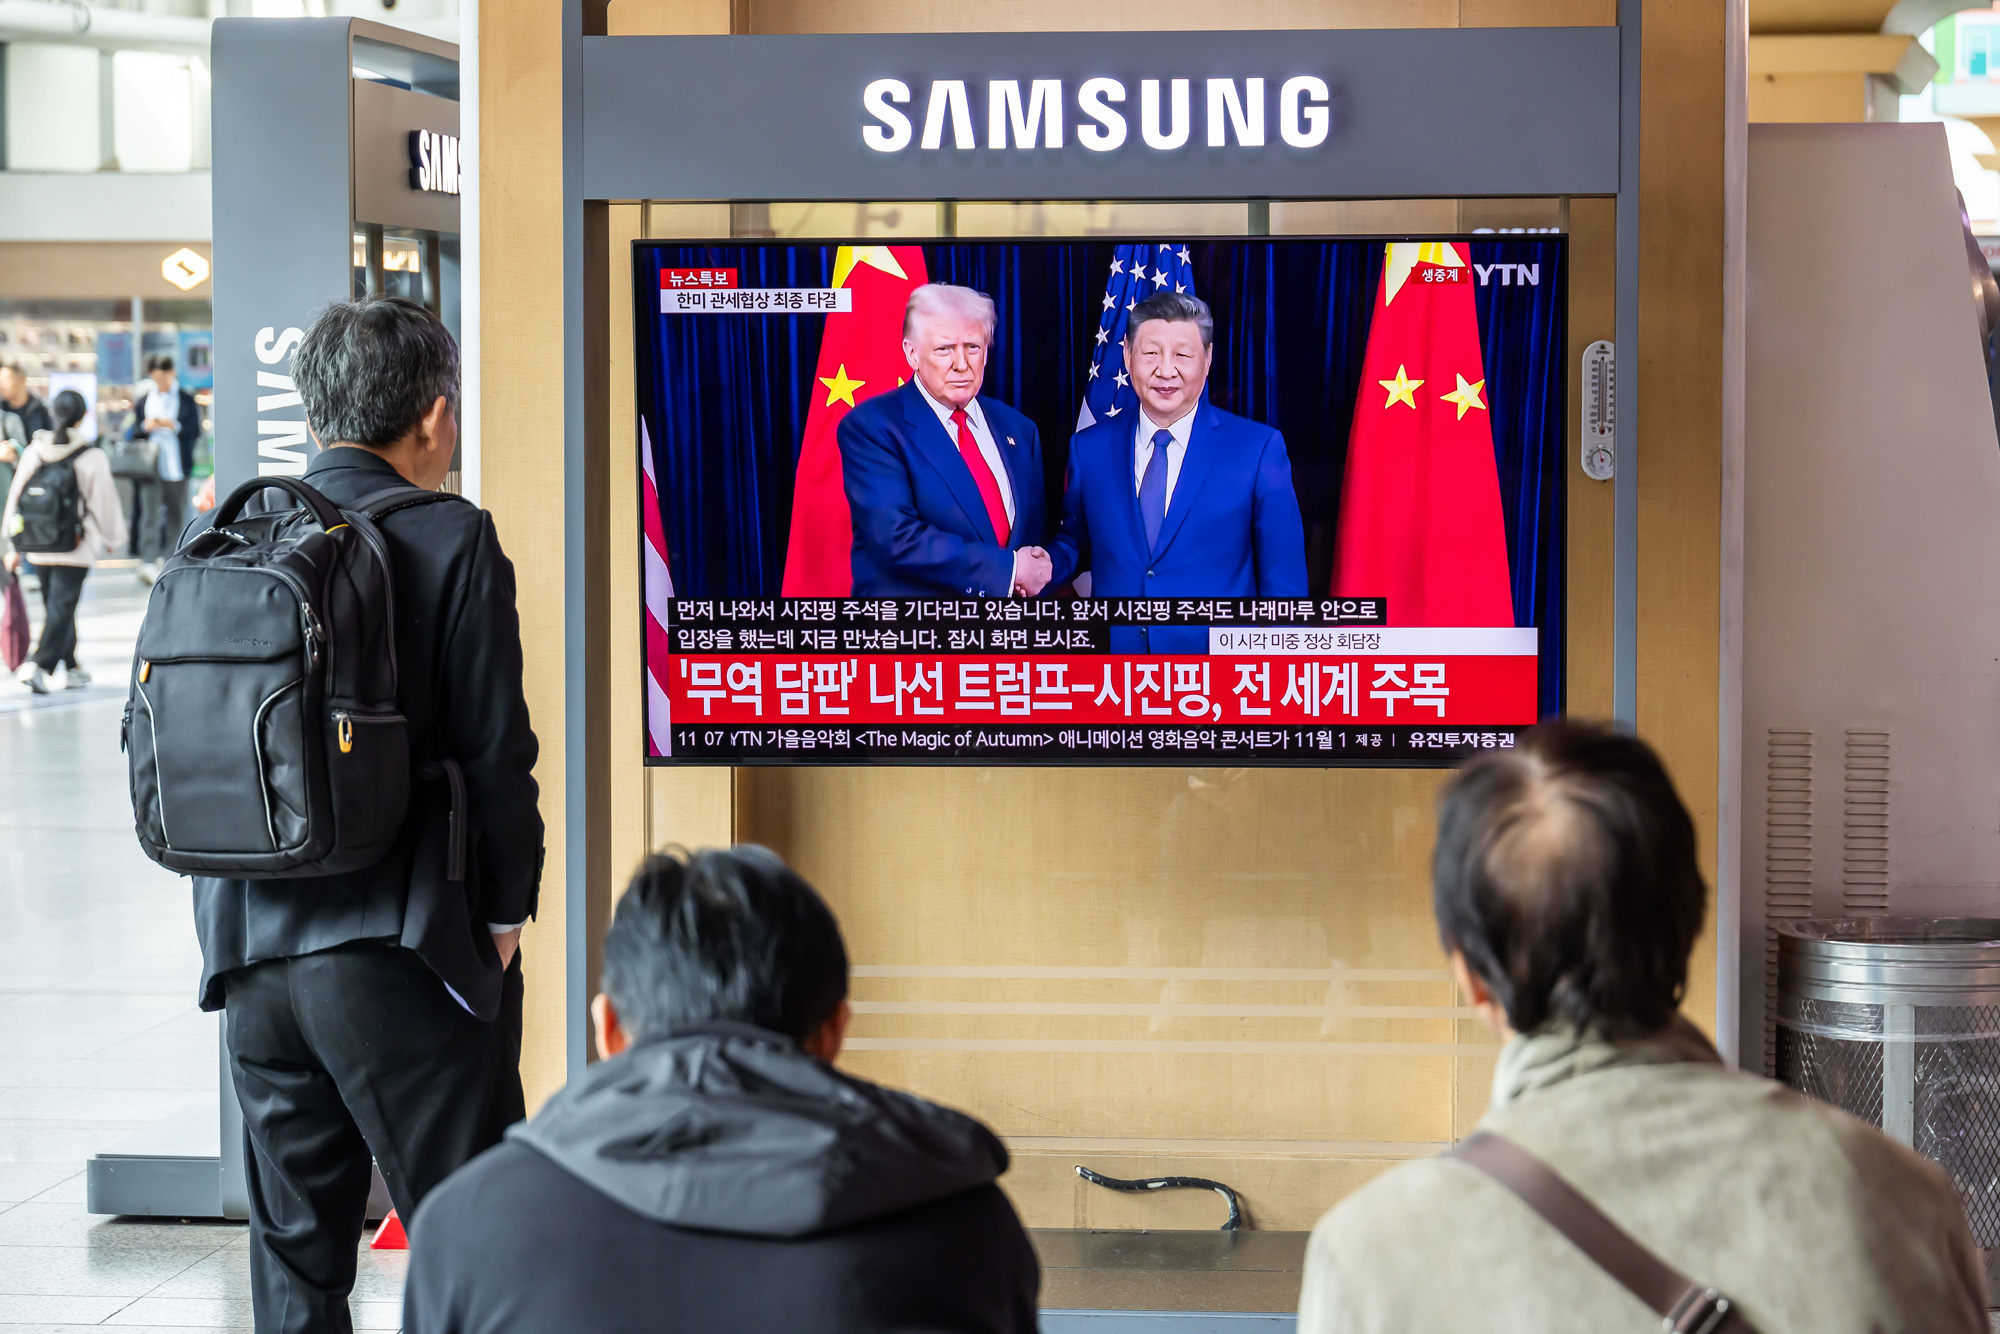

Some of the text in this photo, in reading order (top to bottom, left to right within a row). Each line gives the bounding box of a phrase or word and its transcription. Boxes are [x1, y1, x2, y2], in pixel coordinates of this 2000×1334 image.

[862, 75, 1330, 152] SAMSUNG
[669, 271, 729, 287] 뉴스특보
[1421, 268, 1459, 283] 생중계
[1473, 263, 1540, 286] YTN
[676, 291, 837, 310] 한미 관세협상 최종 타결
[677, 600, 1379, 621] 먼저 나와서 시진핑 주석을 기다리고 있습니다. 앞서 시진핑 주석도 나래마루 안으로
[677, 629, 1096, 650] 입장을 했는데 지금 만났습니다. 잠시 화면 보시죠.
[1219, 632, 1382, 650] 이 시각 미중 정상 회담장
[680, 658, 1450, 722] '무역 담판' 나선 트럼프-시진핑, 전 세계 주목
[678, 731, 696, 746] 11
[704, 731, 724, 746] 07
[730, 730, 762, 746] YTN
[766, 729, 851, 749] 가을음악회
[855, 730, 898, 747] <The
[902, 731, 951, 751] Magic
[954, 730, 973, 747] of
[975, 731, 1054, 747] Autumn>
[1058, 729, 1143, 749] 애니메이션
[1148, 729, 1216, 750] 영화음악
[1220, 729, 1290, 750] 콘서트가
[1294, 730, 1333, 750] 11월
[1355, 732, 1515, 748] 제공 유진투자증권
